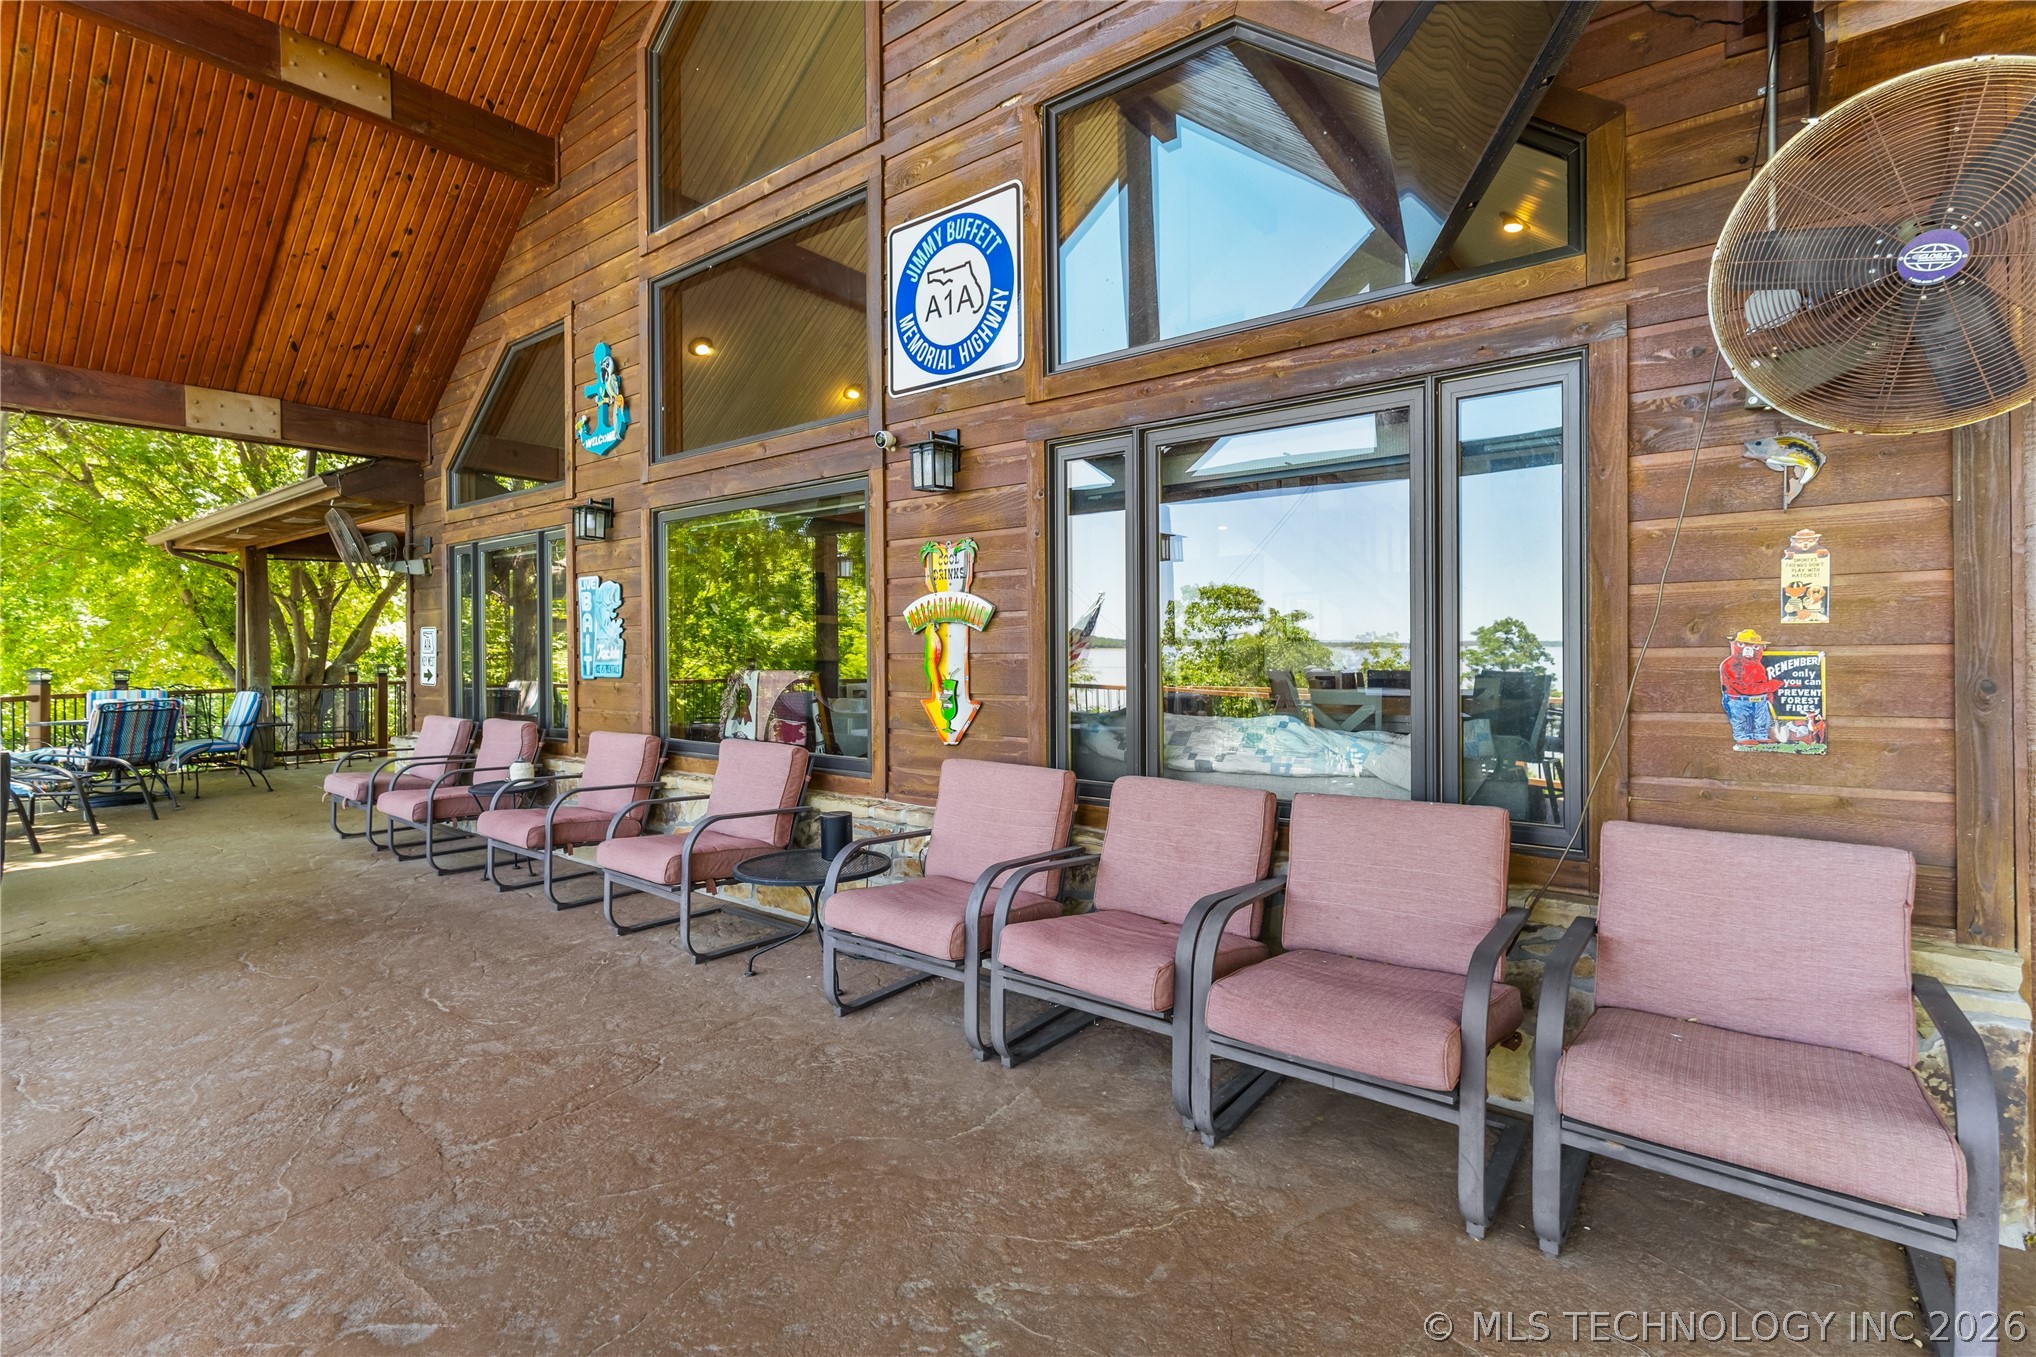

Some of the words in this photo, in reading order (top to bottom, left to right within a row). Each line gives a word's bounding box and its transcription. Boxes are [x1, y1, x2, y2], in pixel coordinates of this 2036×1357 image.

[906, 227, 943, 283] JIMMY
[946, 217, 1002, 255] BUFFETT
[925, 285, 974, 322] A1A
[899, 313, 956, 370] MEMORIAL
[958, 288, 1009, 365] HIGHWAY
[585, 430, 617, 448] WELCOME
[937, 554, 960, 565] COOL
[932, 567, 965, 580] DRINKS
[908, 596, 987, 631] MARGARITAVILLE
[581, 591, 593, 676] BAIT
[1766, 656, 1821, 680] REMEMBER!
[1792, 668, 1816, 678] only
[1784, 678, 1802, 688] you
